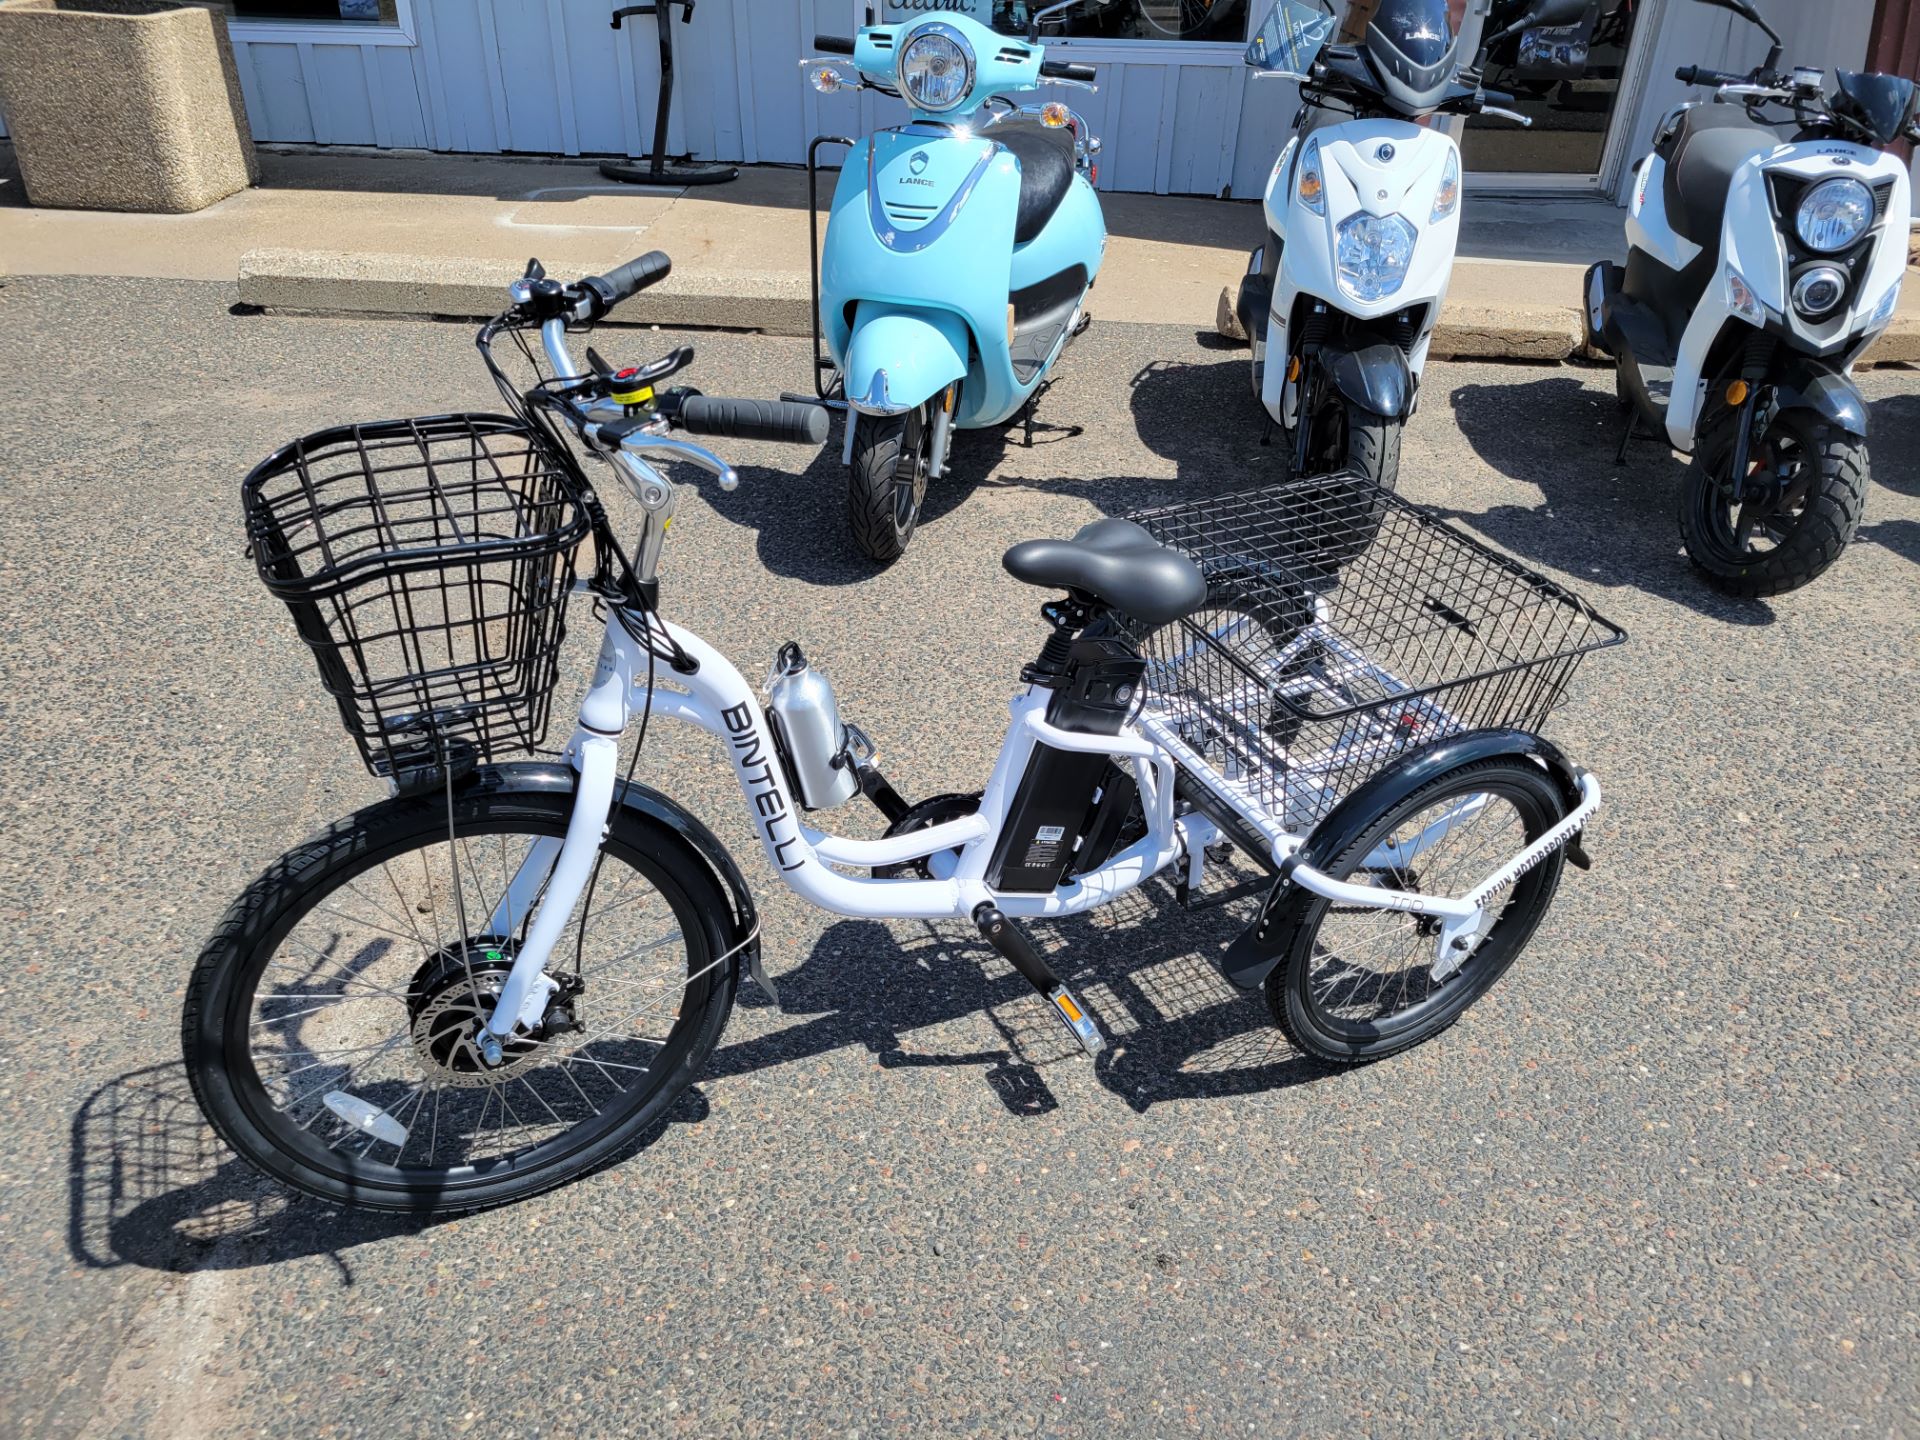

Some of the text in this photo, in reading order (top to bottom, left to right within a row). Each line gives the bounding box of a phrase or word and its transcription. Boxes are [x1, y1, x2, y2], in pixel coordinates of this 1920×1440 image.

[1405, 31, 1441, 42] LANCE
[1816, 148, 1857, 156] LANCE
[898, 177, 935, 188] LANCE
[720, 700, 806, 872] BINTELLI
